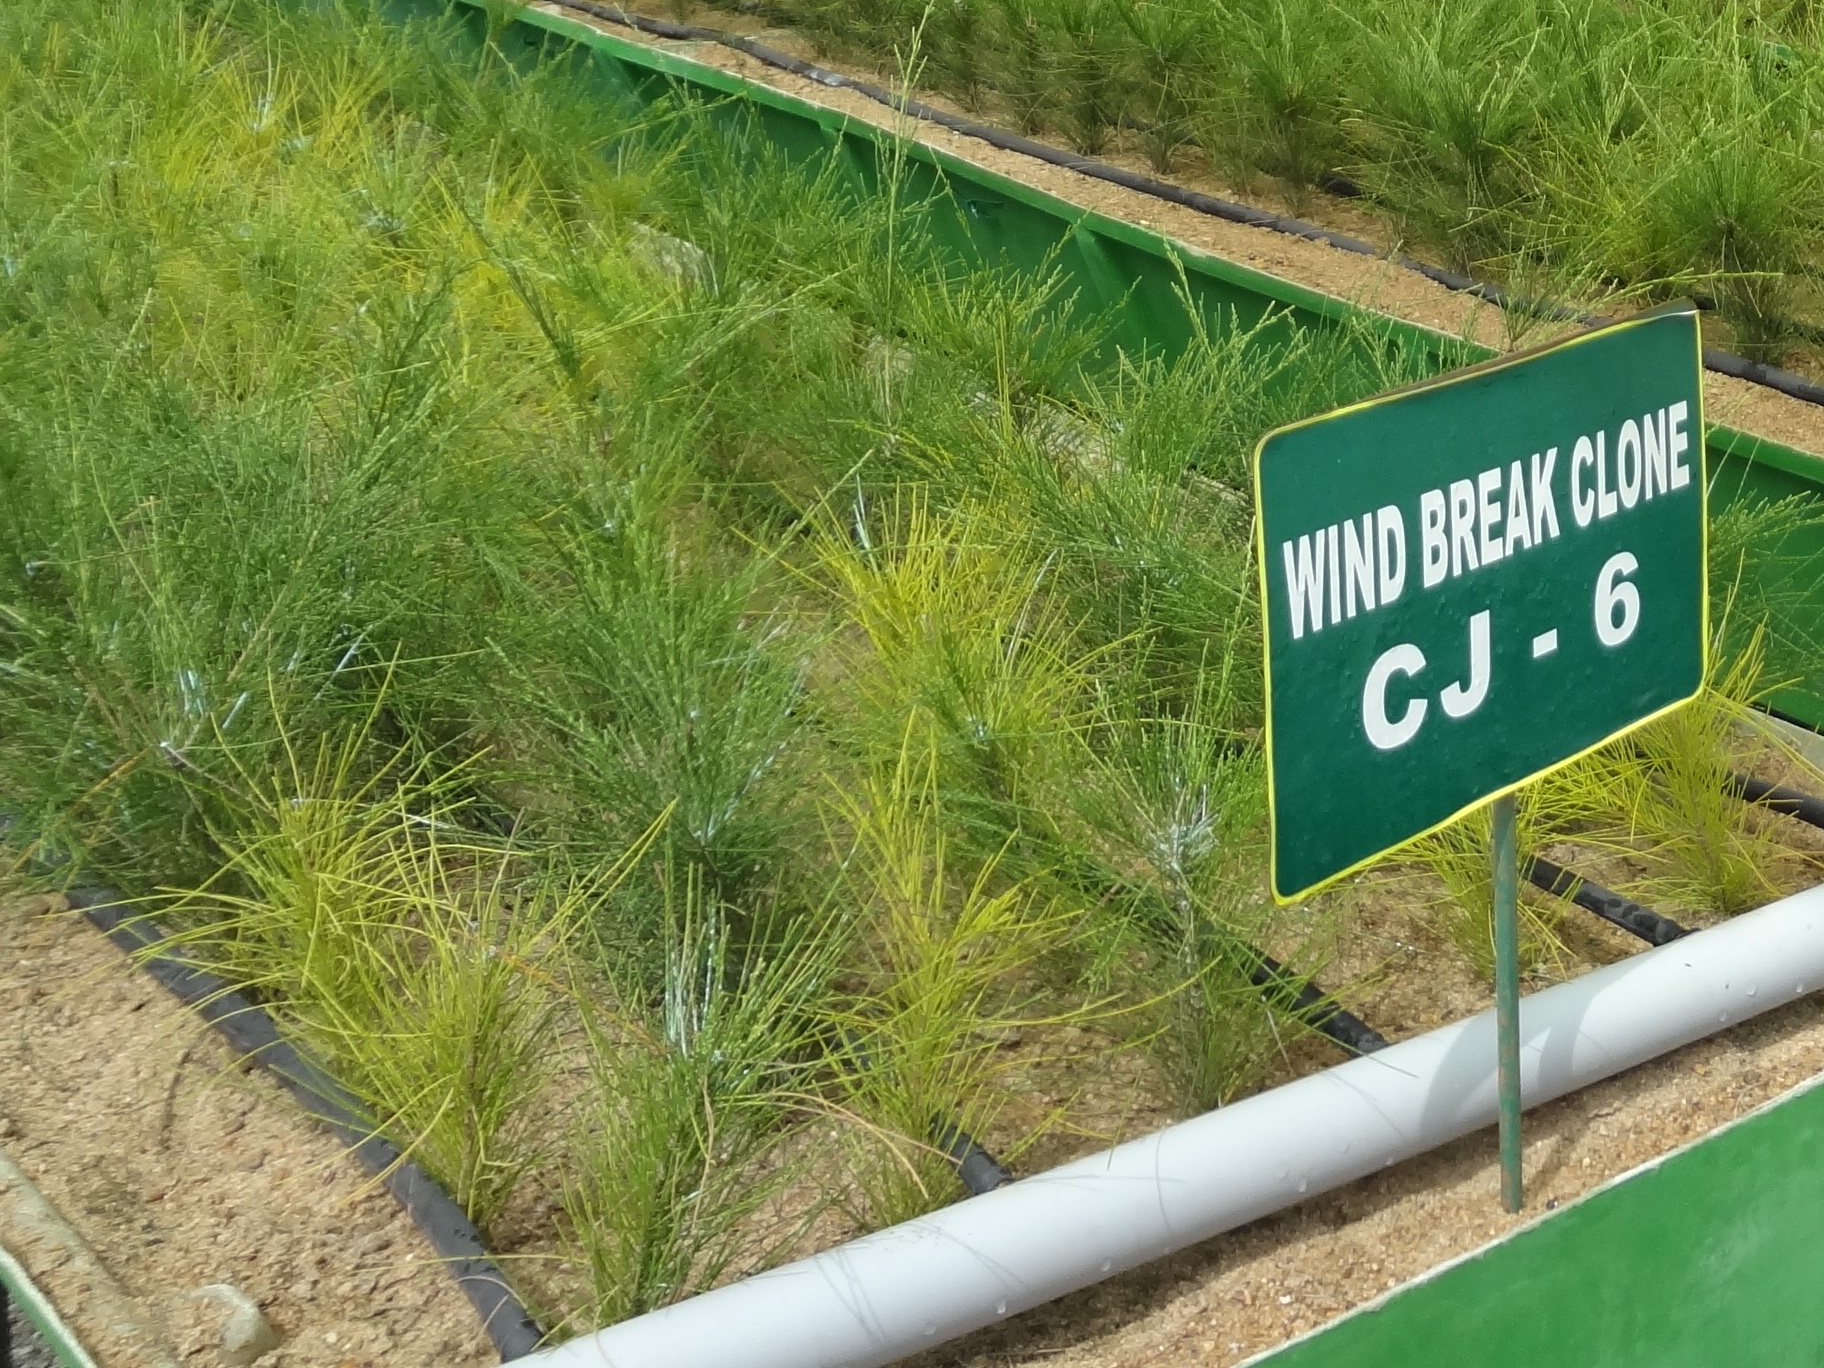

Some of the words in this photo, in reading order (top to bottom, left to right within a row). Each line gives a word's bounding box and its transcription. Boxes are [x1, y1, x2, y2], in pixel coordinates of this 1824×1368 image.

[1283, 505, 1406, 639] WIND
[1421, 447, 1559, 588] BREAK
[1571, 401, 1689, 527] CLONE
[1362, 609, 1490, 749] CJ
[1594, 551, 1640, 646] 6
